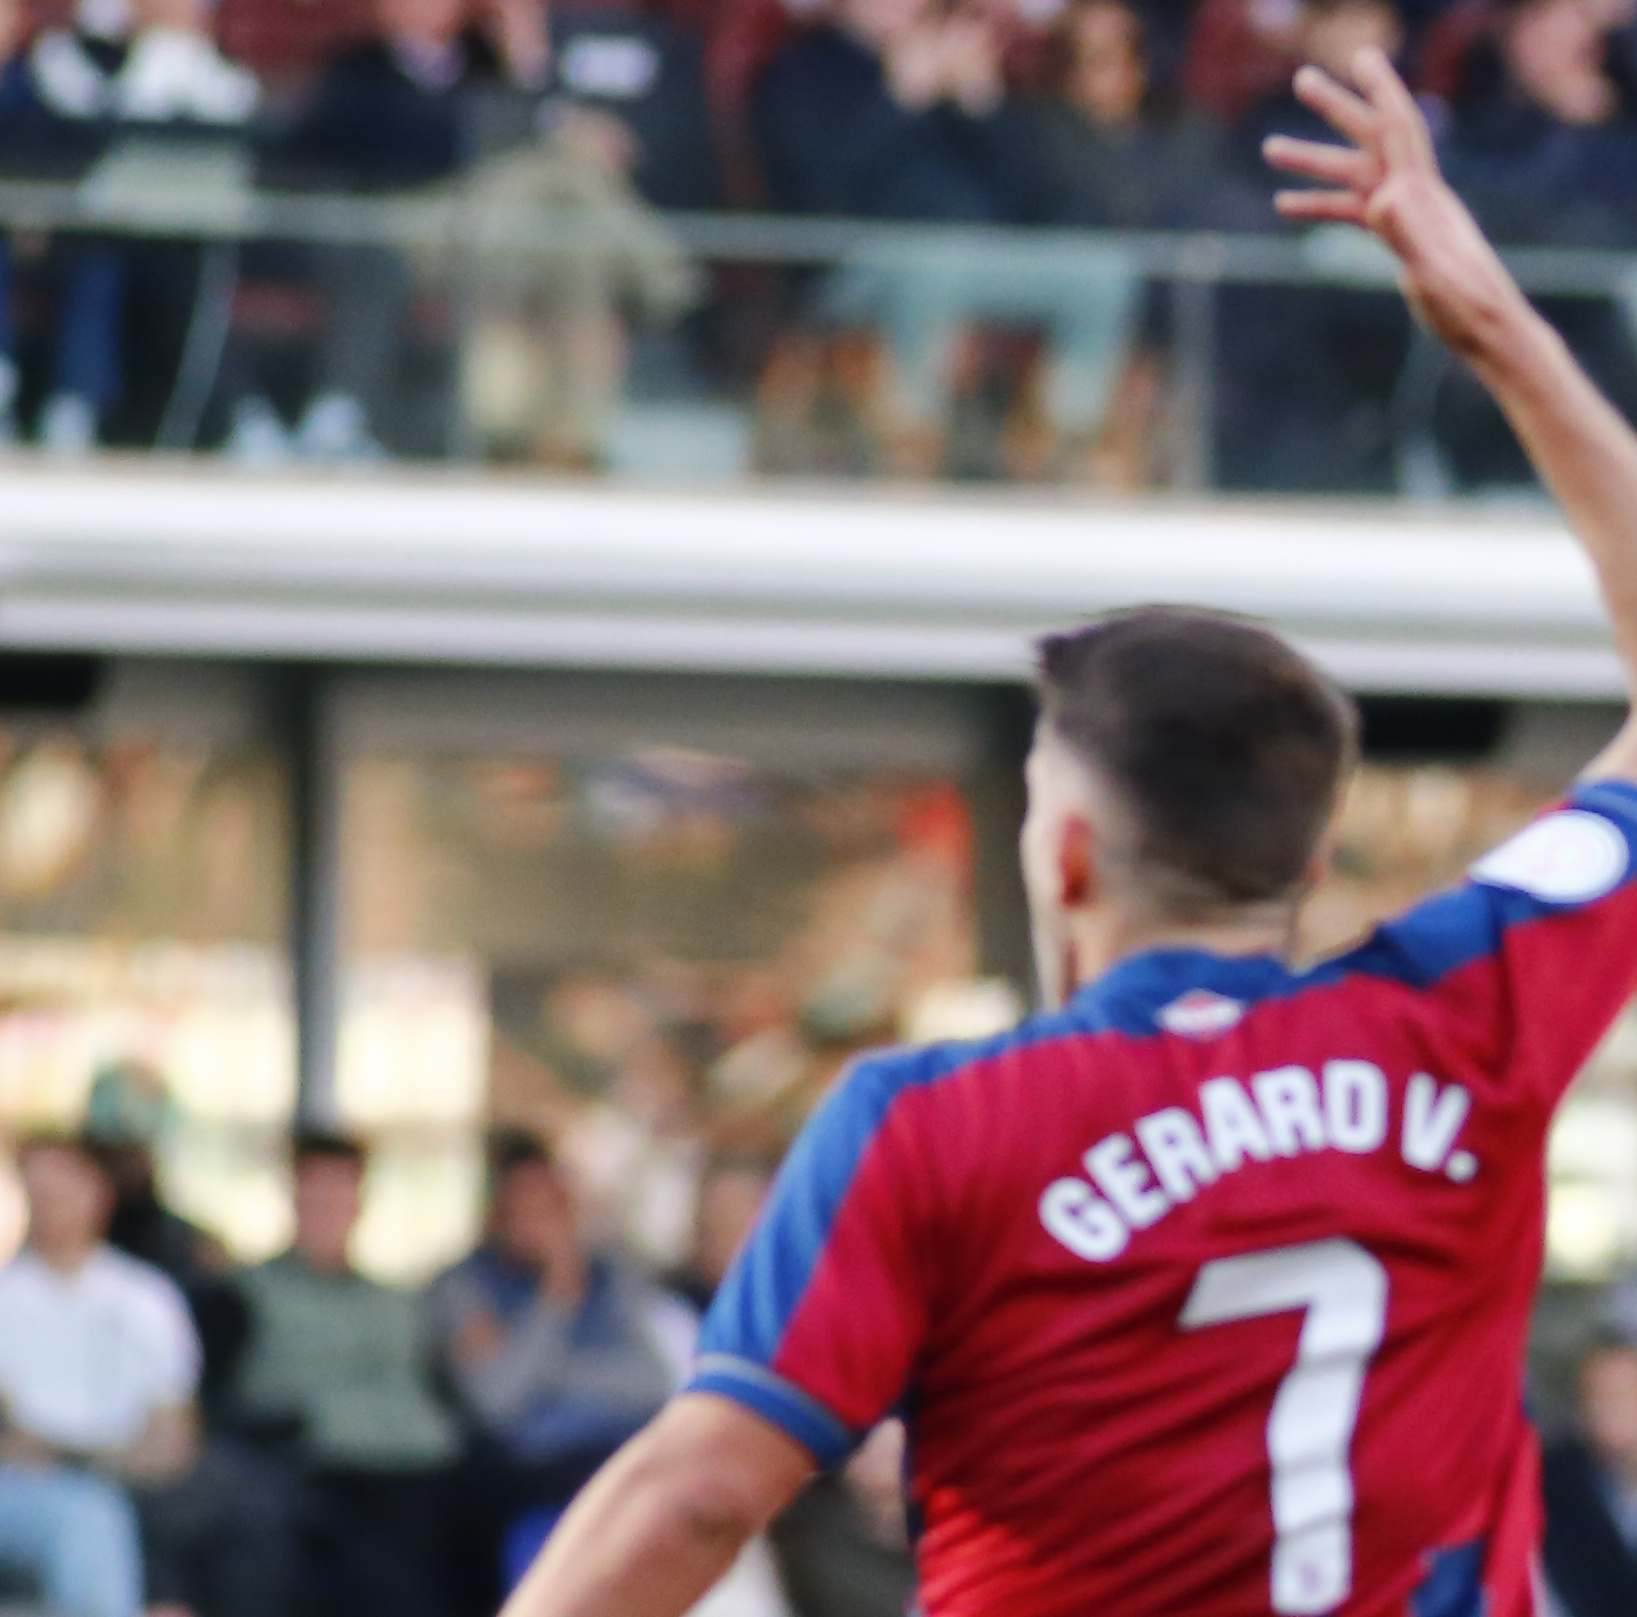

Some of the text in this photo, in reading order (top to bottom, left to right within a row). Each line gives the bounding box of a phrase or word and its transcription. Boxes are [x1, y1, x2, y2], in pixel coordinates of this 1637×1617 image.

[1037, 1058, 1480, 1264] GERARD V.
[1178, 1236, 1391, 1617] 7
